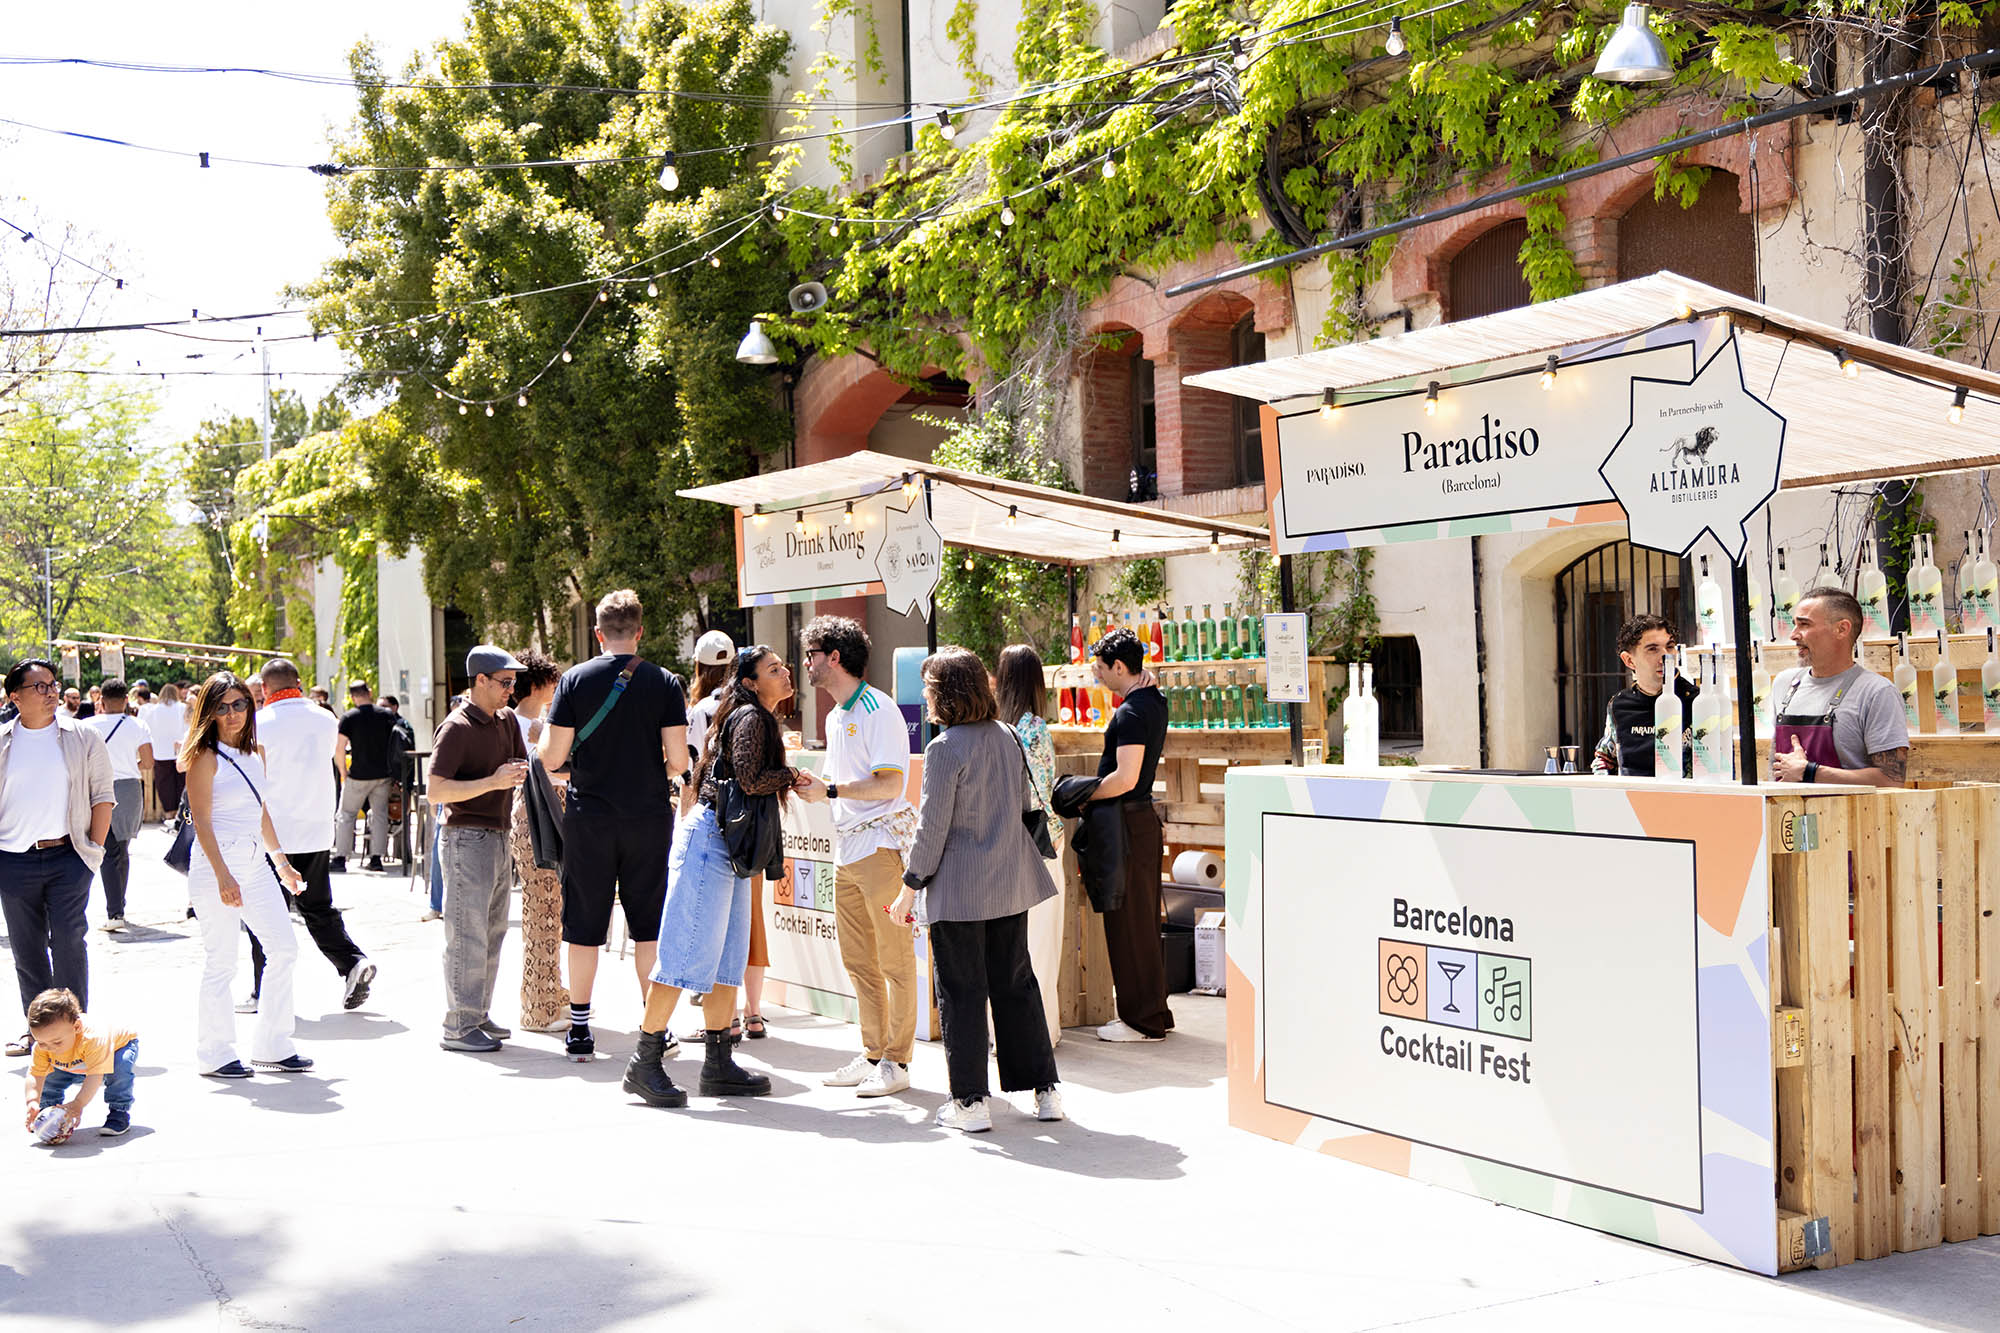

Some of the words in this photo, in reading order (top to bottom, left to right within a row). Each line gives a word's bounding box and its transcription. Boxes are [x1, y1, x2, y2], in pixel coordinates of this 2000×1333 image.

[1659, 409, 1668, 418] In
[1668, 403, 1707, 417] Partnership
[1707, 399, 1724, 410] with
[1401, 413, 1540, 473] Paradiso
[1441, 472, 1501, 495] (Barcelona)
[1650, 462, 1740, 493] ALTAMURA
[1671, 489, 1718, 504] DISTILLERIES
[785, 528, 825, 558] Drink
[829, 524, 865, 560] Kong
[782, 829, 831, 853] Barcelona
[774, 911, 814, 937] Cocktail
[815, 917, 837, 940] Fest
[1393, 897, 1514, 942] Barcelona
[1380, 1025, 1473, 1073] Cocktail
[1480, 1043, 1531, 1084] Fest
